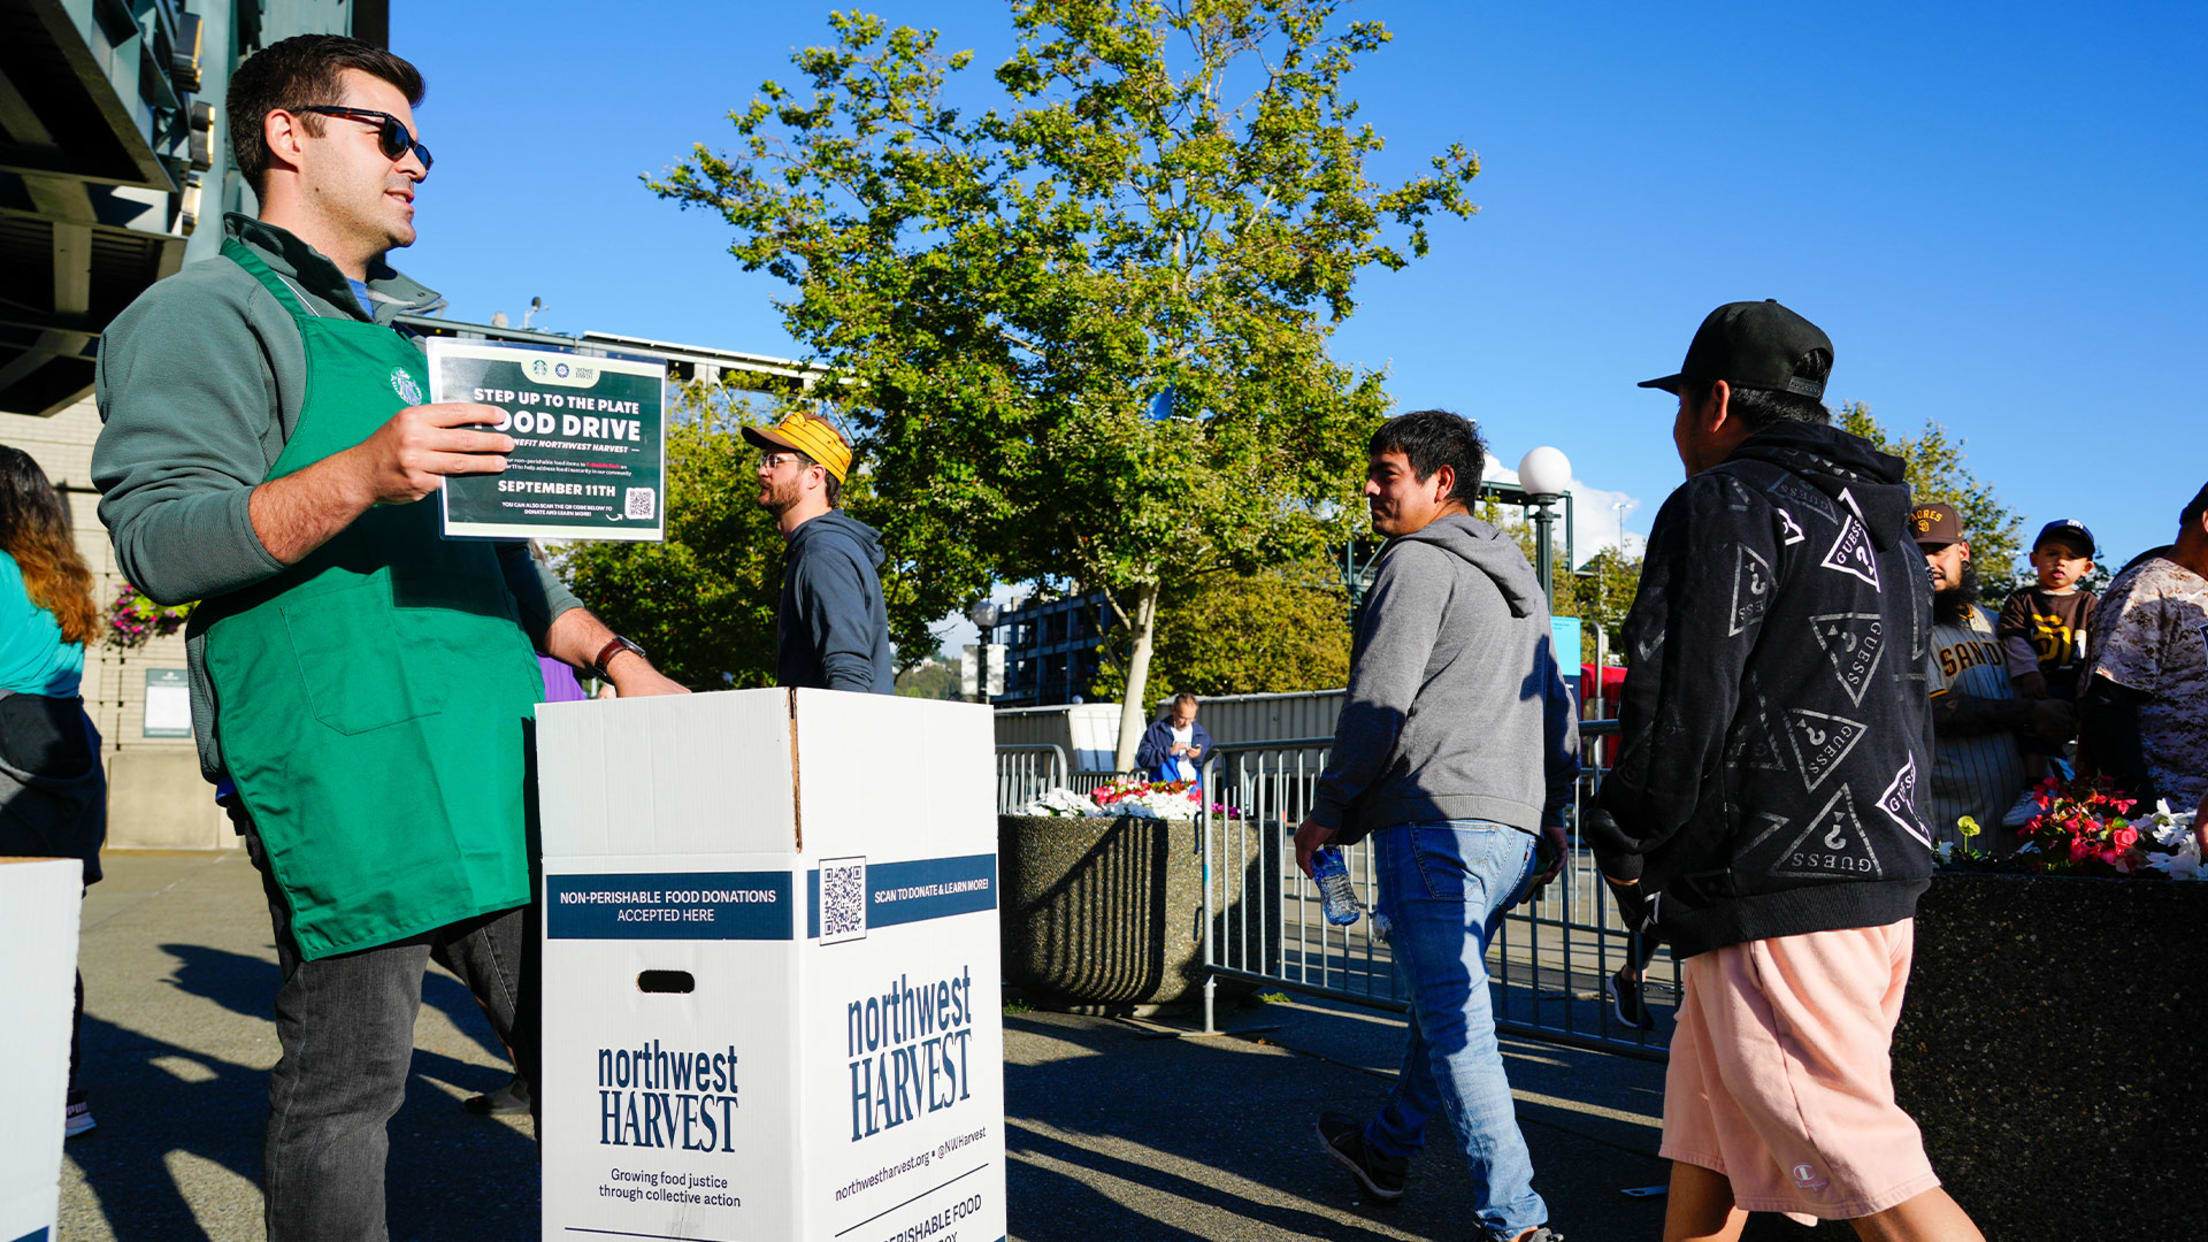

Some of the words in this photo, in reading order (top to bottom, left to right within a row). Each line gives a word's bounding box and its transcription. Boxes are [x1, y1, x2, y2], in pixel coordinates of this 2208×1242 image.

[474, 388, 515, 403] STEP
[518, 391, 540, 405] UP
[543, 393, 564, 407] TO
[567, 396, 595, 410] THE
[598, 398, 640, 415] PLATE
[475, 410, 556, 434] OOD
[562, 414, 641, 442] DRIVE
[538, 440, 592, 451] NORTHWEST
[592, 444, 628, 453] HARVEST
[498, 480, 582, 495] SEPTEMBER
[585, 484, 616, 497] 11TH
[1836, 520, 1863, 565] GUESS
[1847, 622, 1882, 685] GUESS
[1808, 725, 1852, 774] GUESS
[1791, 852, 1872, 873] GUESS
[560, 891, 661, 904] NON-PERISHABLE
[665, 890, 699, 904] FOOD
[701, 889, 776, 904] DONATIONS
[874, 888, 897, 904] SCAN
[897, 887, 908, 900] TO
[908, 883, 938, 899] DONATE
[938, 883, 944, 895] &
[944, 880, 967, 894] LEARN
[967, 878, 989, 891] MORE!
[617, 909, 680, 922] ACCEPTED
[683, 909, 715, 922] HERE
[848, 964, 972, 1058] northwest
[598, 1039, 738, 1094] northwest
[849, 1028, 972, 1142] HARVEST
[599, 1090, 739, 1153] HARVEST
[611, 1167, 659, 1187] Growing
[660, 1171, 686, 1186] food
[688, 1173, 728, 1189] justice
[835, 1150, 930, 1202] northwestharvest.org
[937, 1127, 987, 1159] @NWHarvest
[599, 1184, 643, 1202] through
[645, 1188, 701, 1204] collective
[704, 1193, 741, 1207] action
[953, 1194, 982, 1222] FOOD
